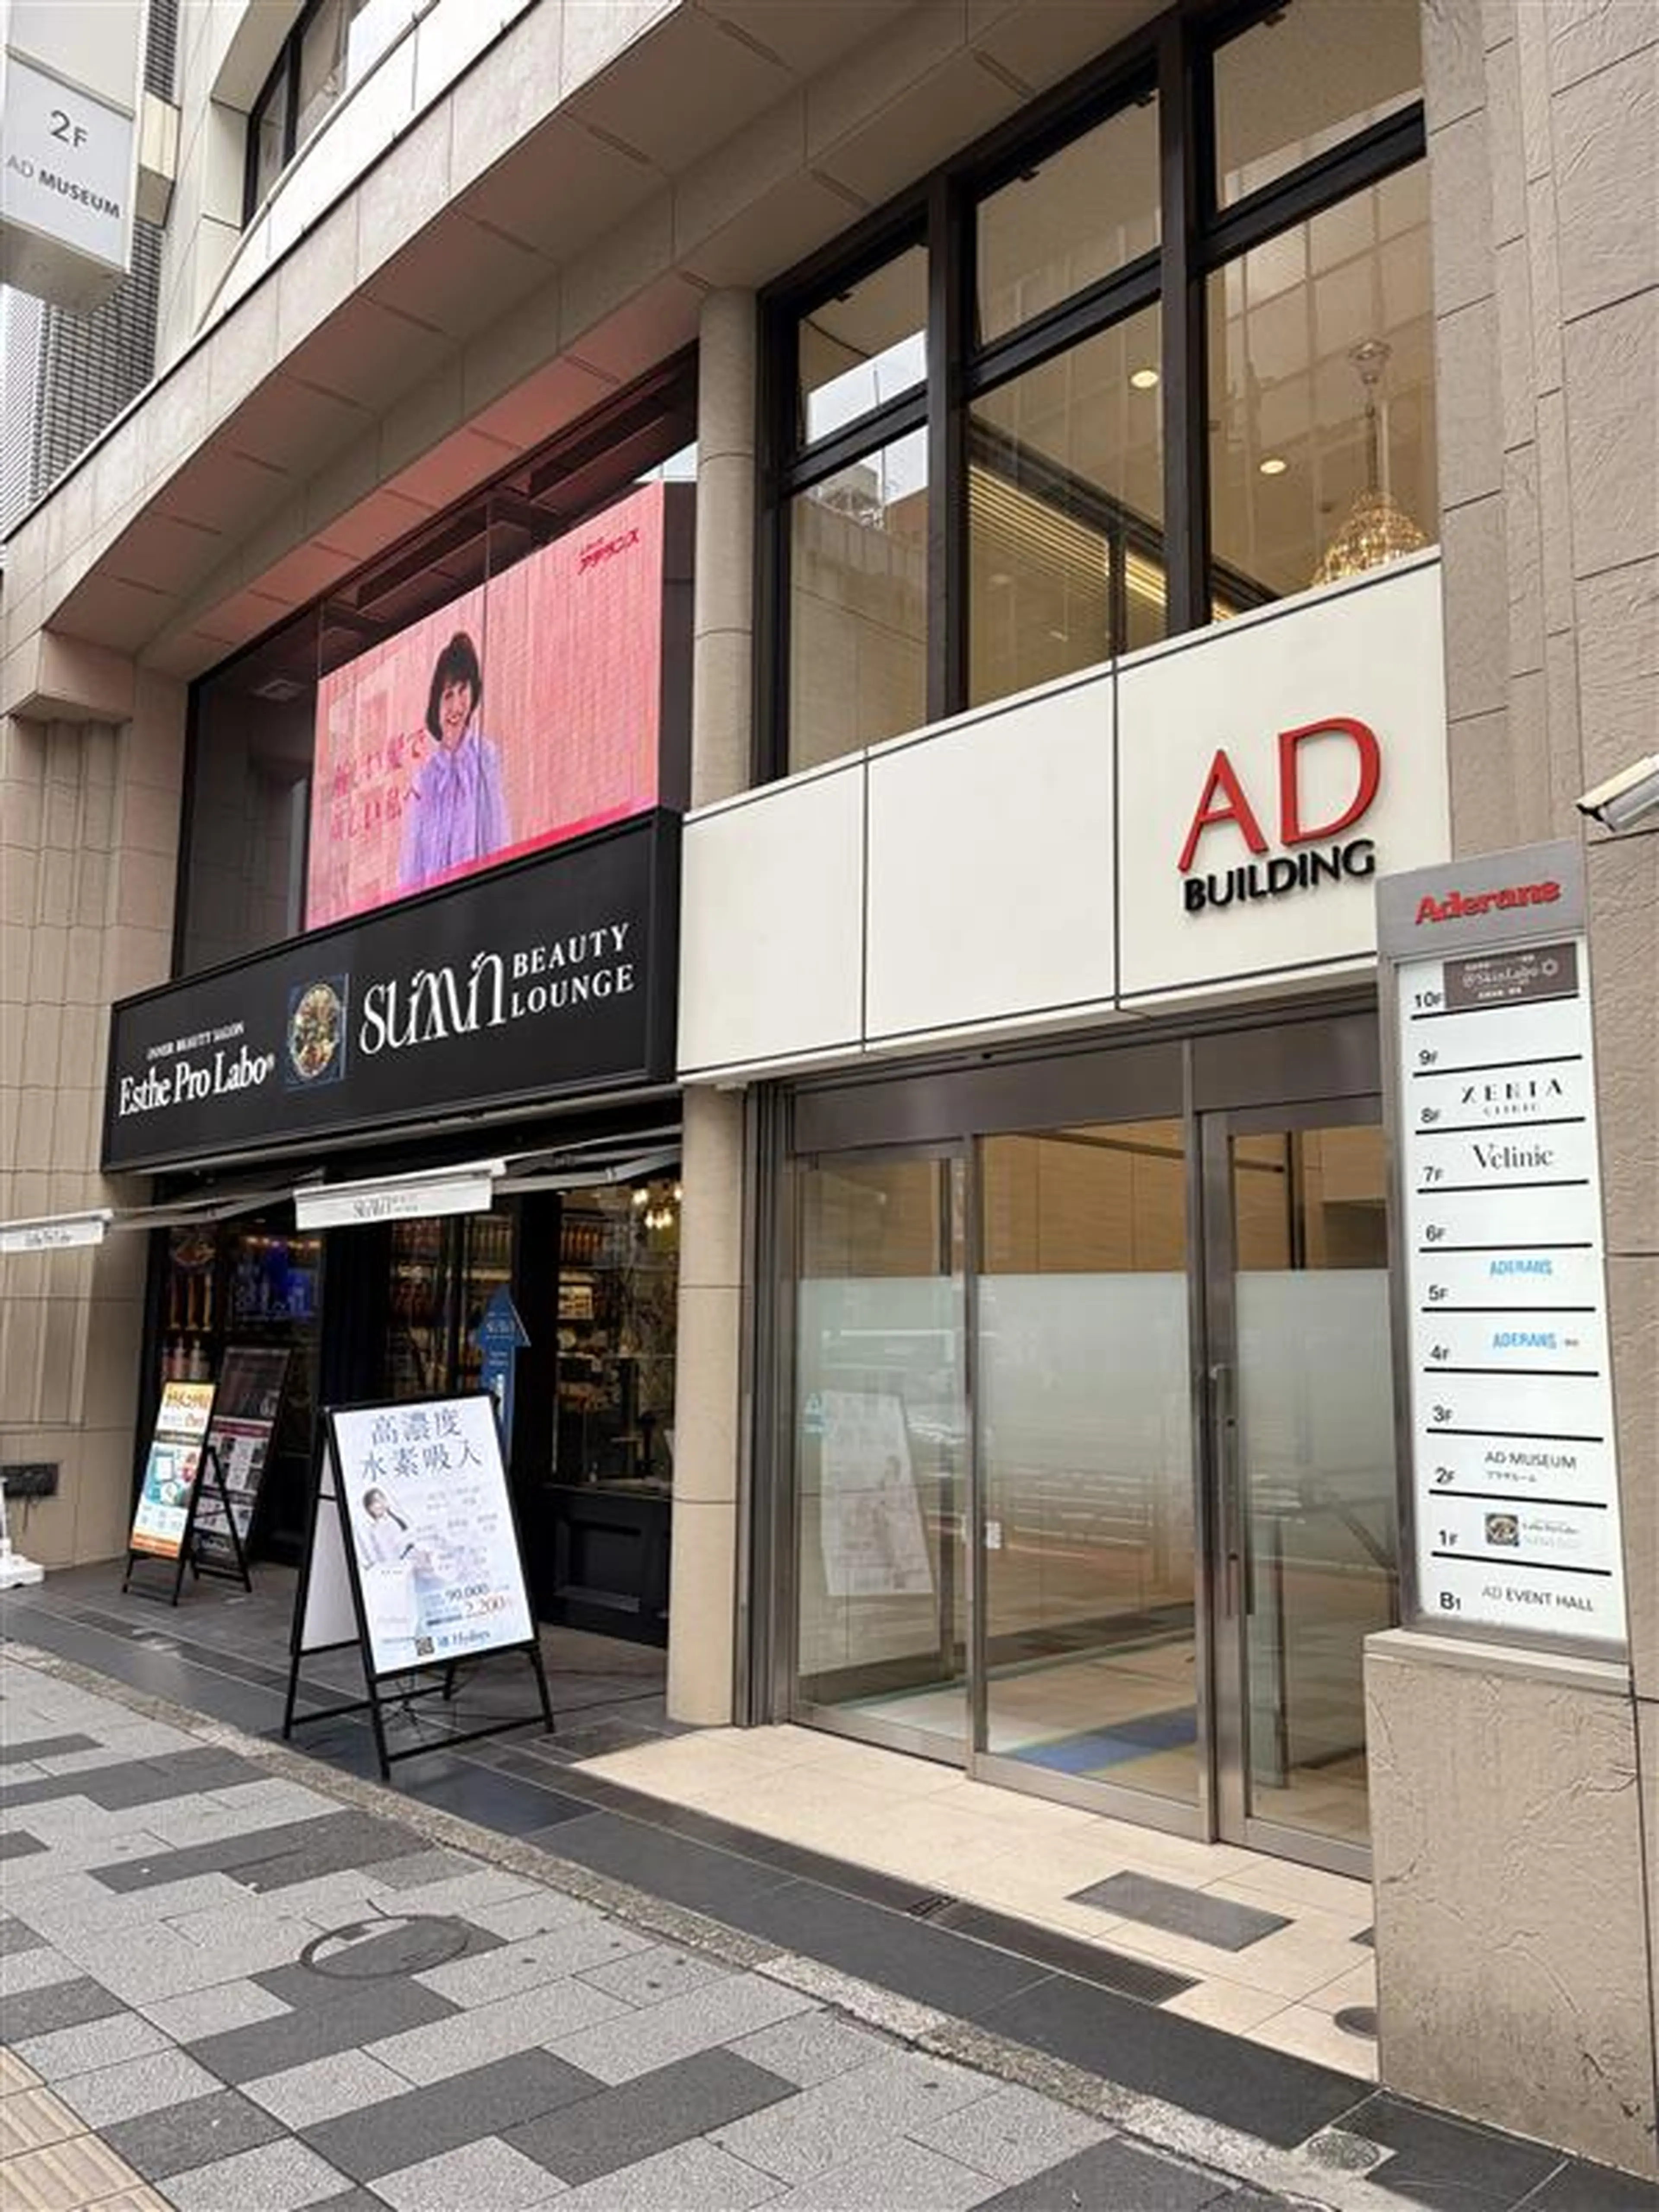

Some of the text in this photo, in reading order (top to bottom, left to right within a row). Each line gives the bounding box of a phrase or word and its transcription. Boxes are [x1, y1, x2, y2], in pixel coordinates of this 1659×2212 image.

[51, 110, 88, 147] 2F
[6, 155, 121, 219] AD MUSEUM
[1177, 718, 1381, 872] AD
[1183, 839, 1376, 911] BUILDING
[1415, 881, 1561, 925] Aderans
[512, 922, 629, 1001] BEAUTY
[511, 964, 635, 1019] LOUNGE
[1419, 1049, 1438, 1065] 9F
[119, 1065, 171, 1116] Esthe
[174, 1062, 210, 1103] Pro
[1421, 1108, 1442, 1123] 8F
[1423, 1166, 1444, 1182] 7F
[1426, 1225, 1447, 1242] 6F
[1490, 1259, 1553, 1277] ADERANS
[1428, 1284, 1449, 1301] 5F
[1493, 1332, 1557, 1350] ADERANS
[1430, 1345, 1449, 1361] 4F
[1433, 1405, 1453, 1423] 3F
[372, 1408, 462, 1445] 高濃度
[361, 1439, 482, 1482] 水素吸入
[1484, 1451, 1577, 1470] AD MUSEUM
[1435, 1467, 1456, 1485] 2F
[1439, 1529, 1459, 1547] 1F
[1440, 1592, 1462, 1611] B1
[1482, 1586, 1593, 1612] AD EVENT HALL
